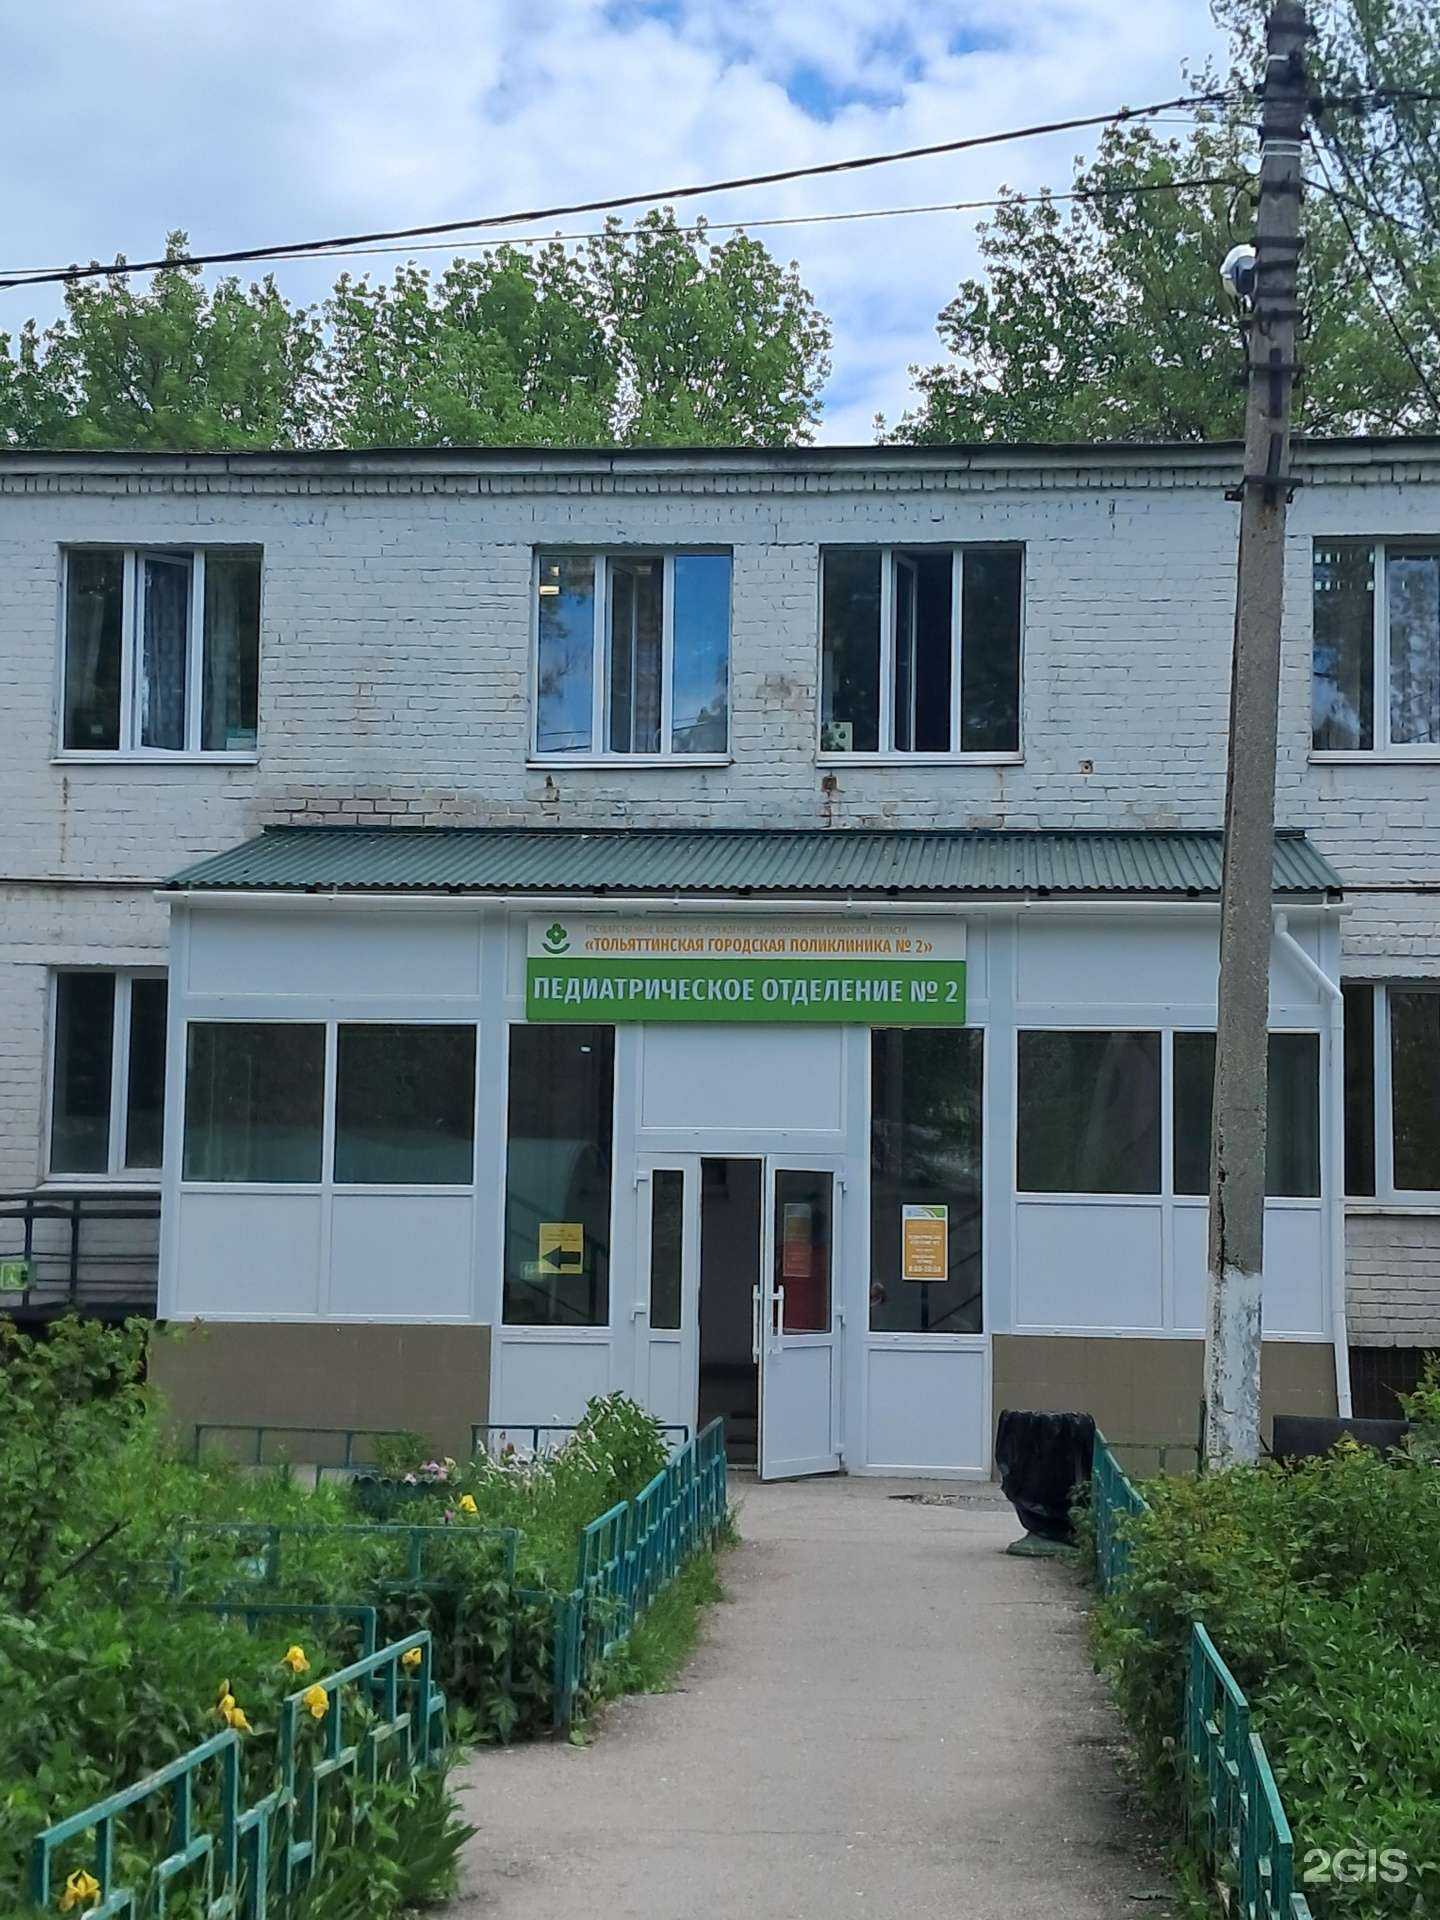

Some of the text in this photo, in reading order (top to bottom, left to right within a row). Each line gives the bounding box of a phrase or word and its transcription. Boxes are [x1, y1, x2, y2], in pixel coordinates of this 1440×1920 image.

[585, 937, 933, 954] «ТОЛЬЯТТИНСКАЯ ГОРОДСКАЯ ПОЛИКЛИНИКА № 2»
[534, 977, 958, 1006] ПЕДИАТРИЧЕСКОЕ ОТДЕЛЕНИЕ № 2
